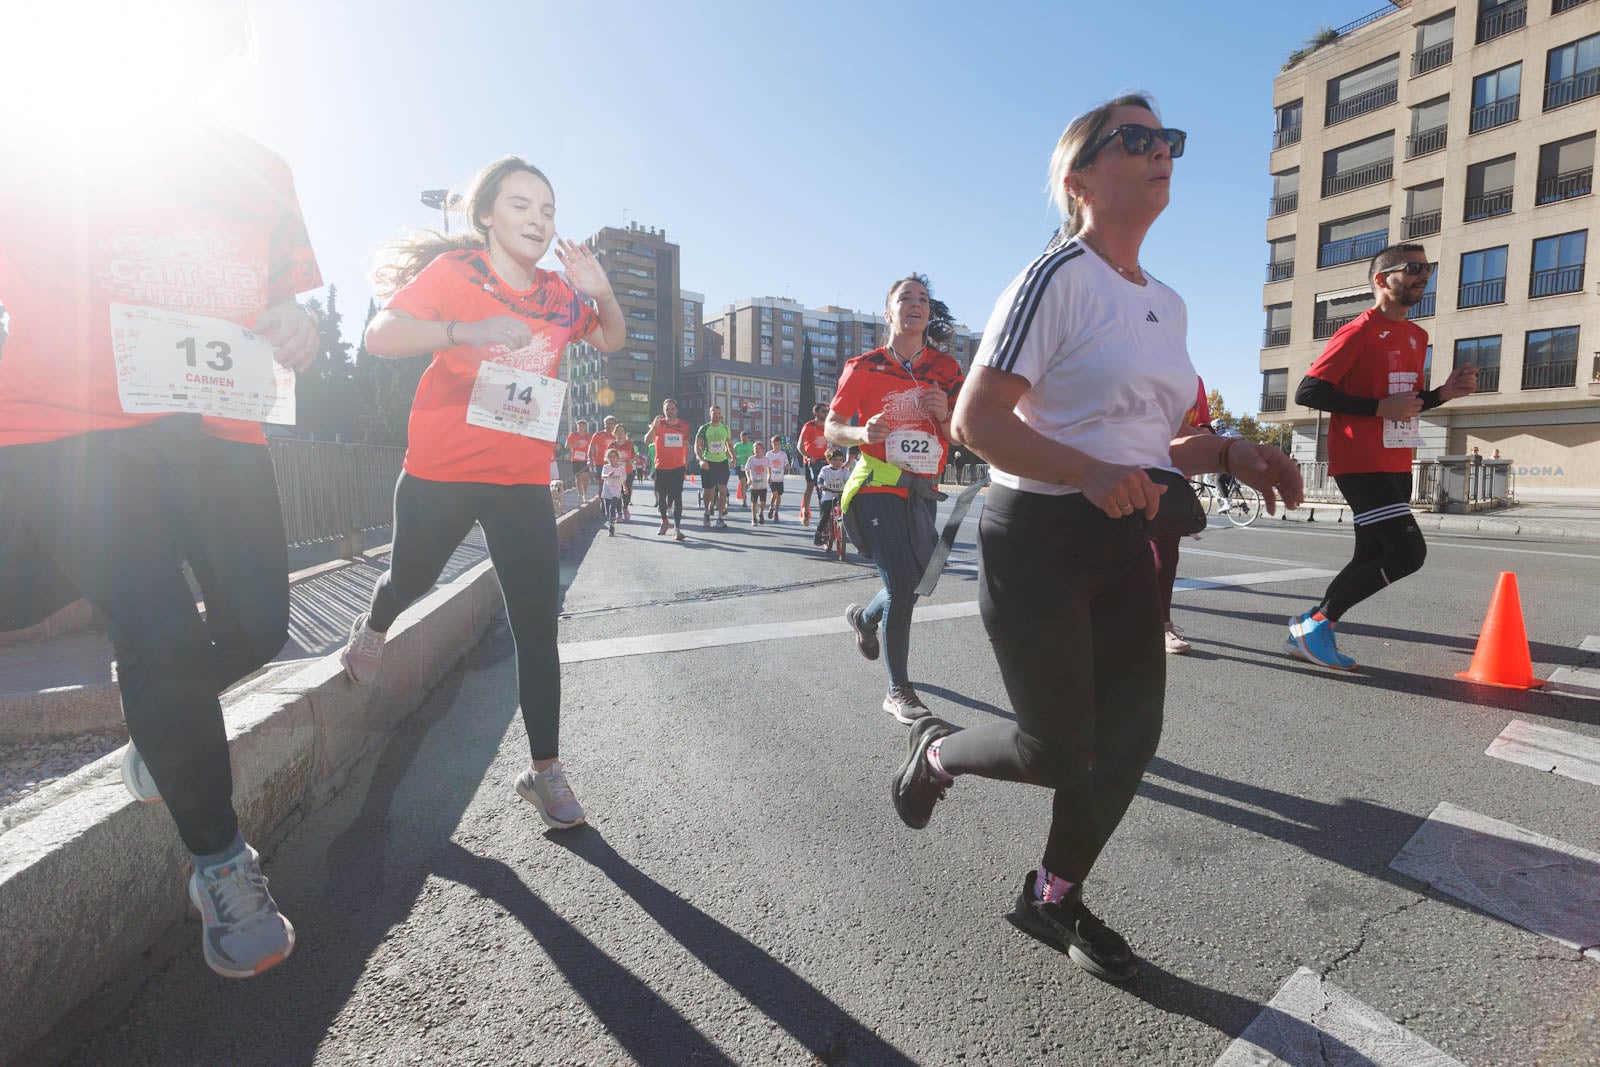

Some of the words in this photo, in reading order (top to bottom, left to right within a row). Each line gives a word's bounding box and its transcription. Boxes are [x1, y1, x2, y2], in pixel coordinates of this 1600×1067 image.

[175, 337, 234, 372] 13
[186, 373, 234, 388] CARMEN
[505, 382, 533, 405] 14
[502, 404, 531, 416] CATALINA
[901, 440, 930, 453] 622
